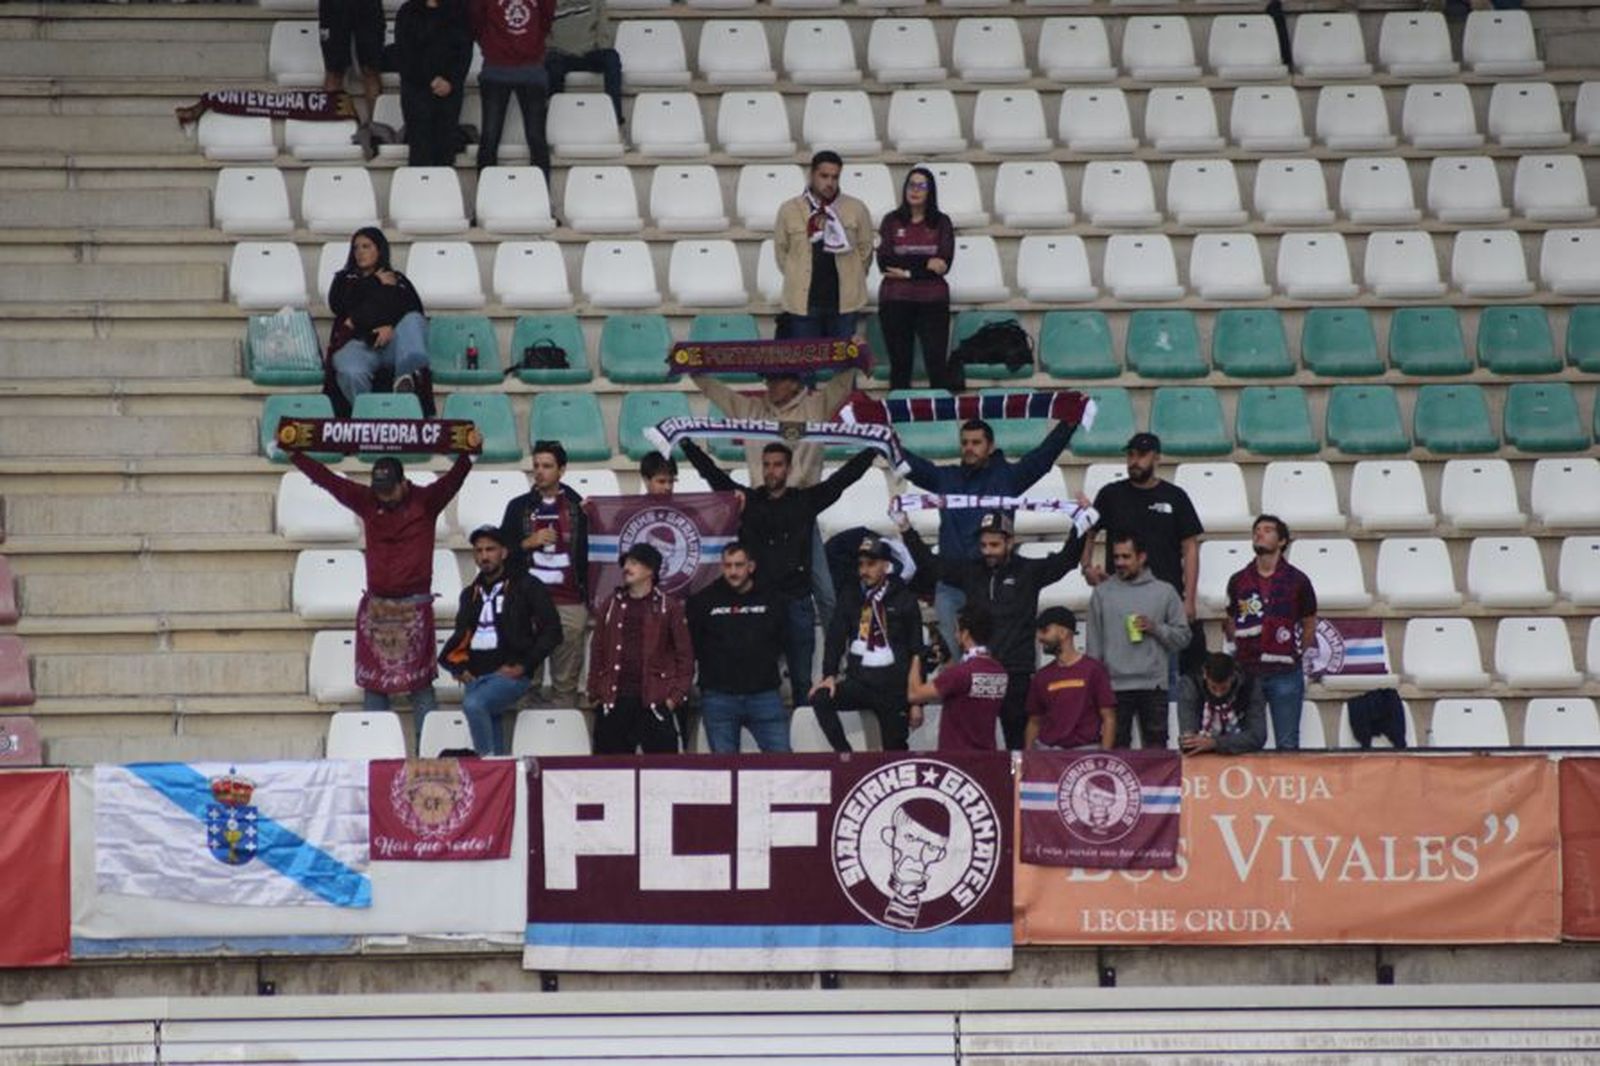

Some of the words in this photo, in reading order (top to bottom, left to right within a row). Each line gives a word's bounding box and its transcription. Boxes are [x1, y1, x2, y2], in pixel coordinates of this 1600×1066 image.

[307, 93, 328, 111] CF
[321, 421, 418, 443] PONTEVEDRA
[422, 423, 441, 444] CF
[1219, 765, 1334, 804] OVEJA
[542, 769, 832, 890] PCF
[938, 769, 996, 908] GRANATES
[413, 841, 443, 857] que
[1081, 909, 1177, 932] LECHE
[1184, 908, 1293, 933] CRUDA
